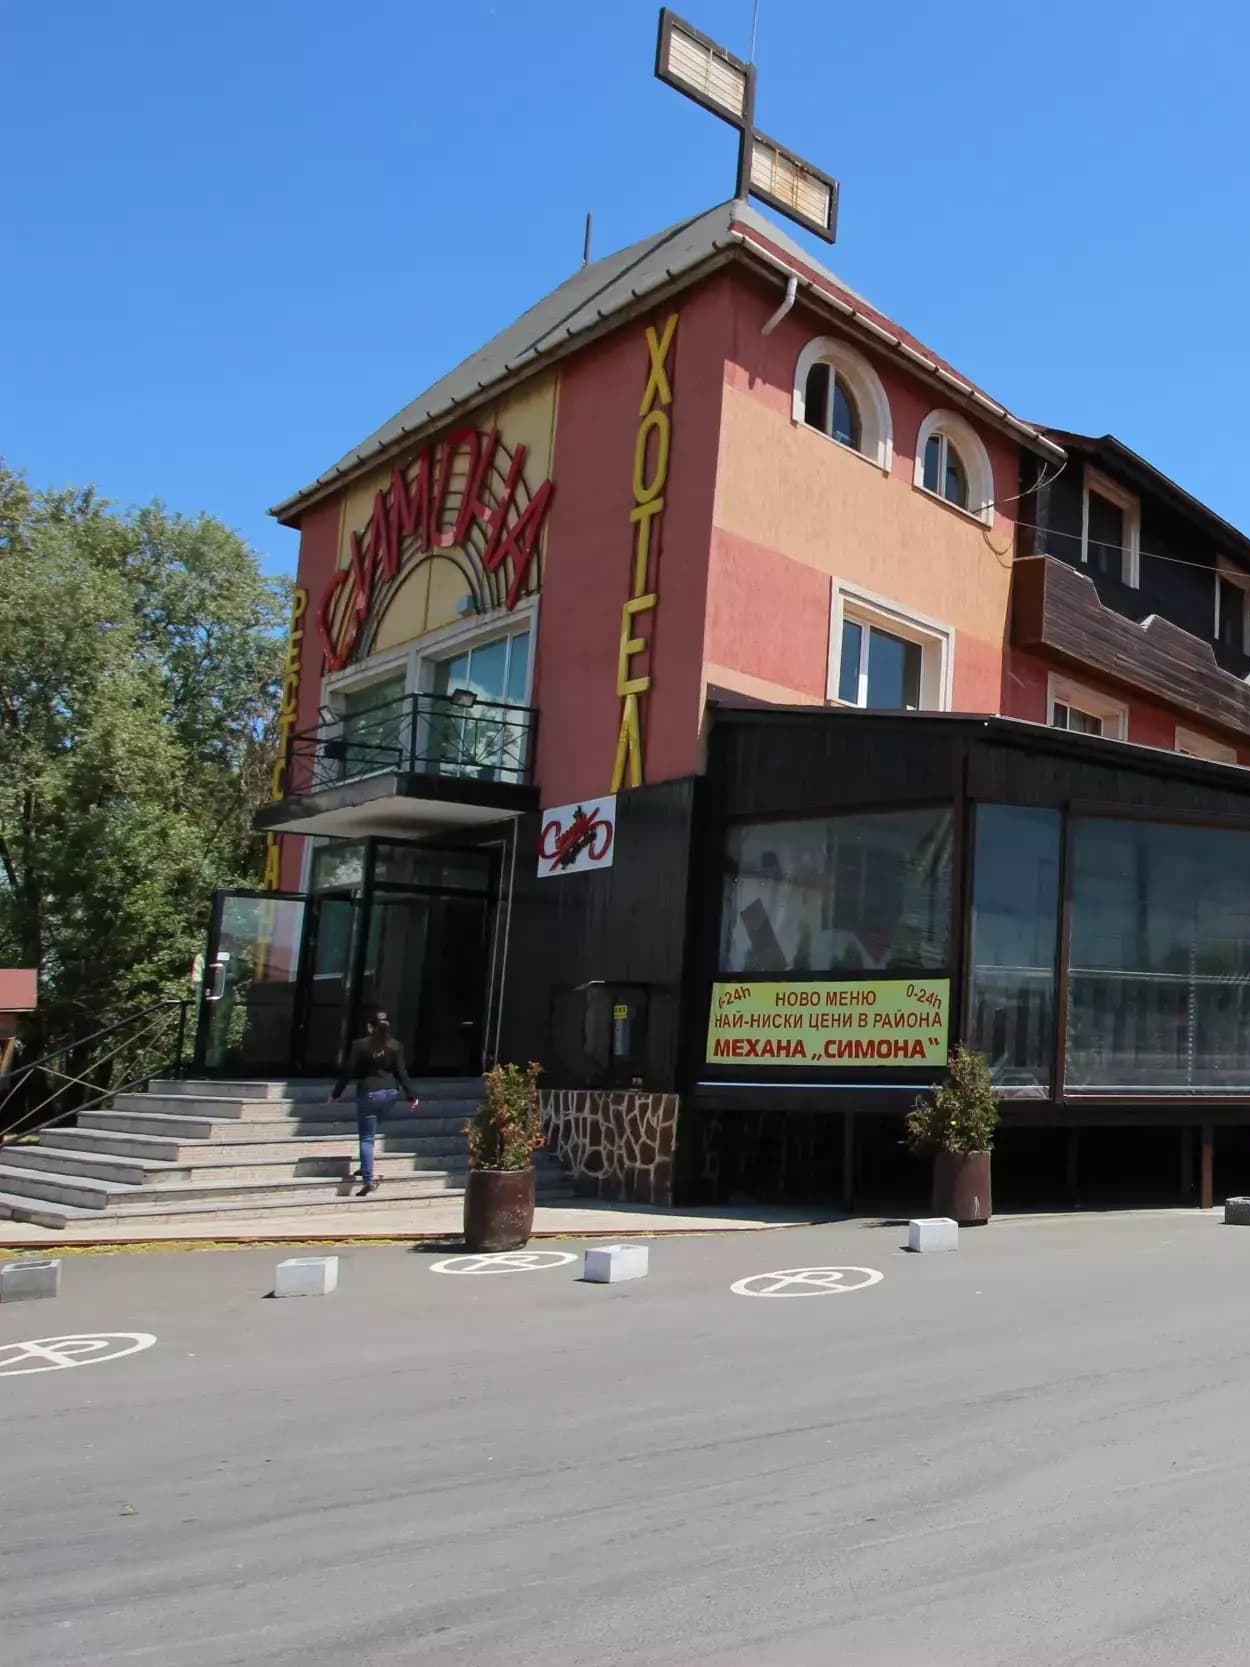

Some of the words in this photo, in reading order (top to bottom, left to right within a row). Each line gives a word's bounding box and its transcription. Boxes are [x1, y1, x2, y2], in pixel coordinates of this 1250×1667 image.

[318, 427, 557, 672] СИМОНА
[609, 313, 679, 793] ХОТЕЛ
[775, 991, 820, 1007] НОВО
[826, 990, 877, 1006] МЕНЮ
[906, 983, 942, 1010] 0-24h
[714, 1010, 803, 1029] НАЙ-НИСКИ
[808, 1012, 853, 1031] ЦЕНИ
[858, 1012, 868, 1029] В
[873, 1009, 943, 1029] РАЙОНА
[713, 1038, 807, 1058] МЕХАНА
